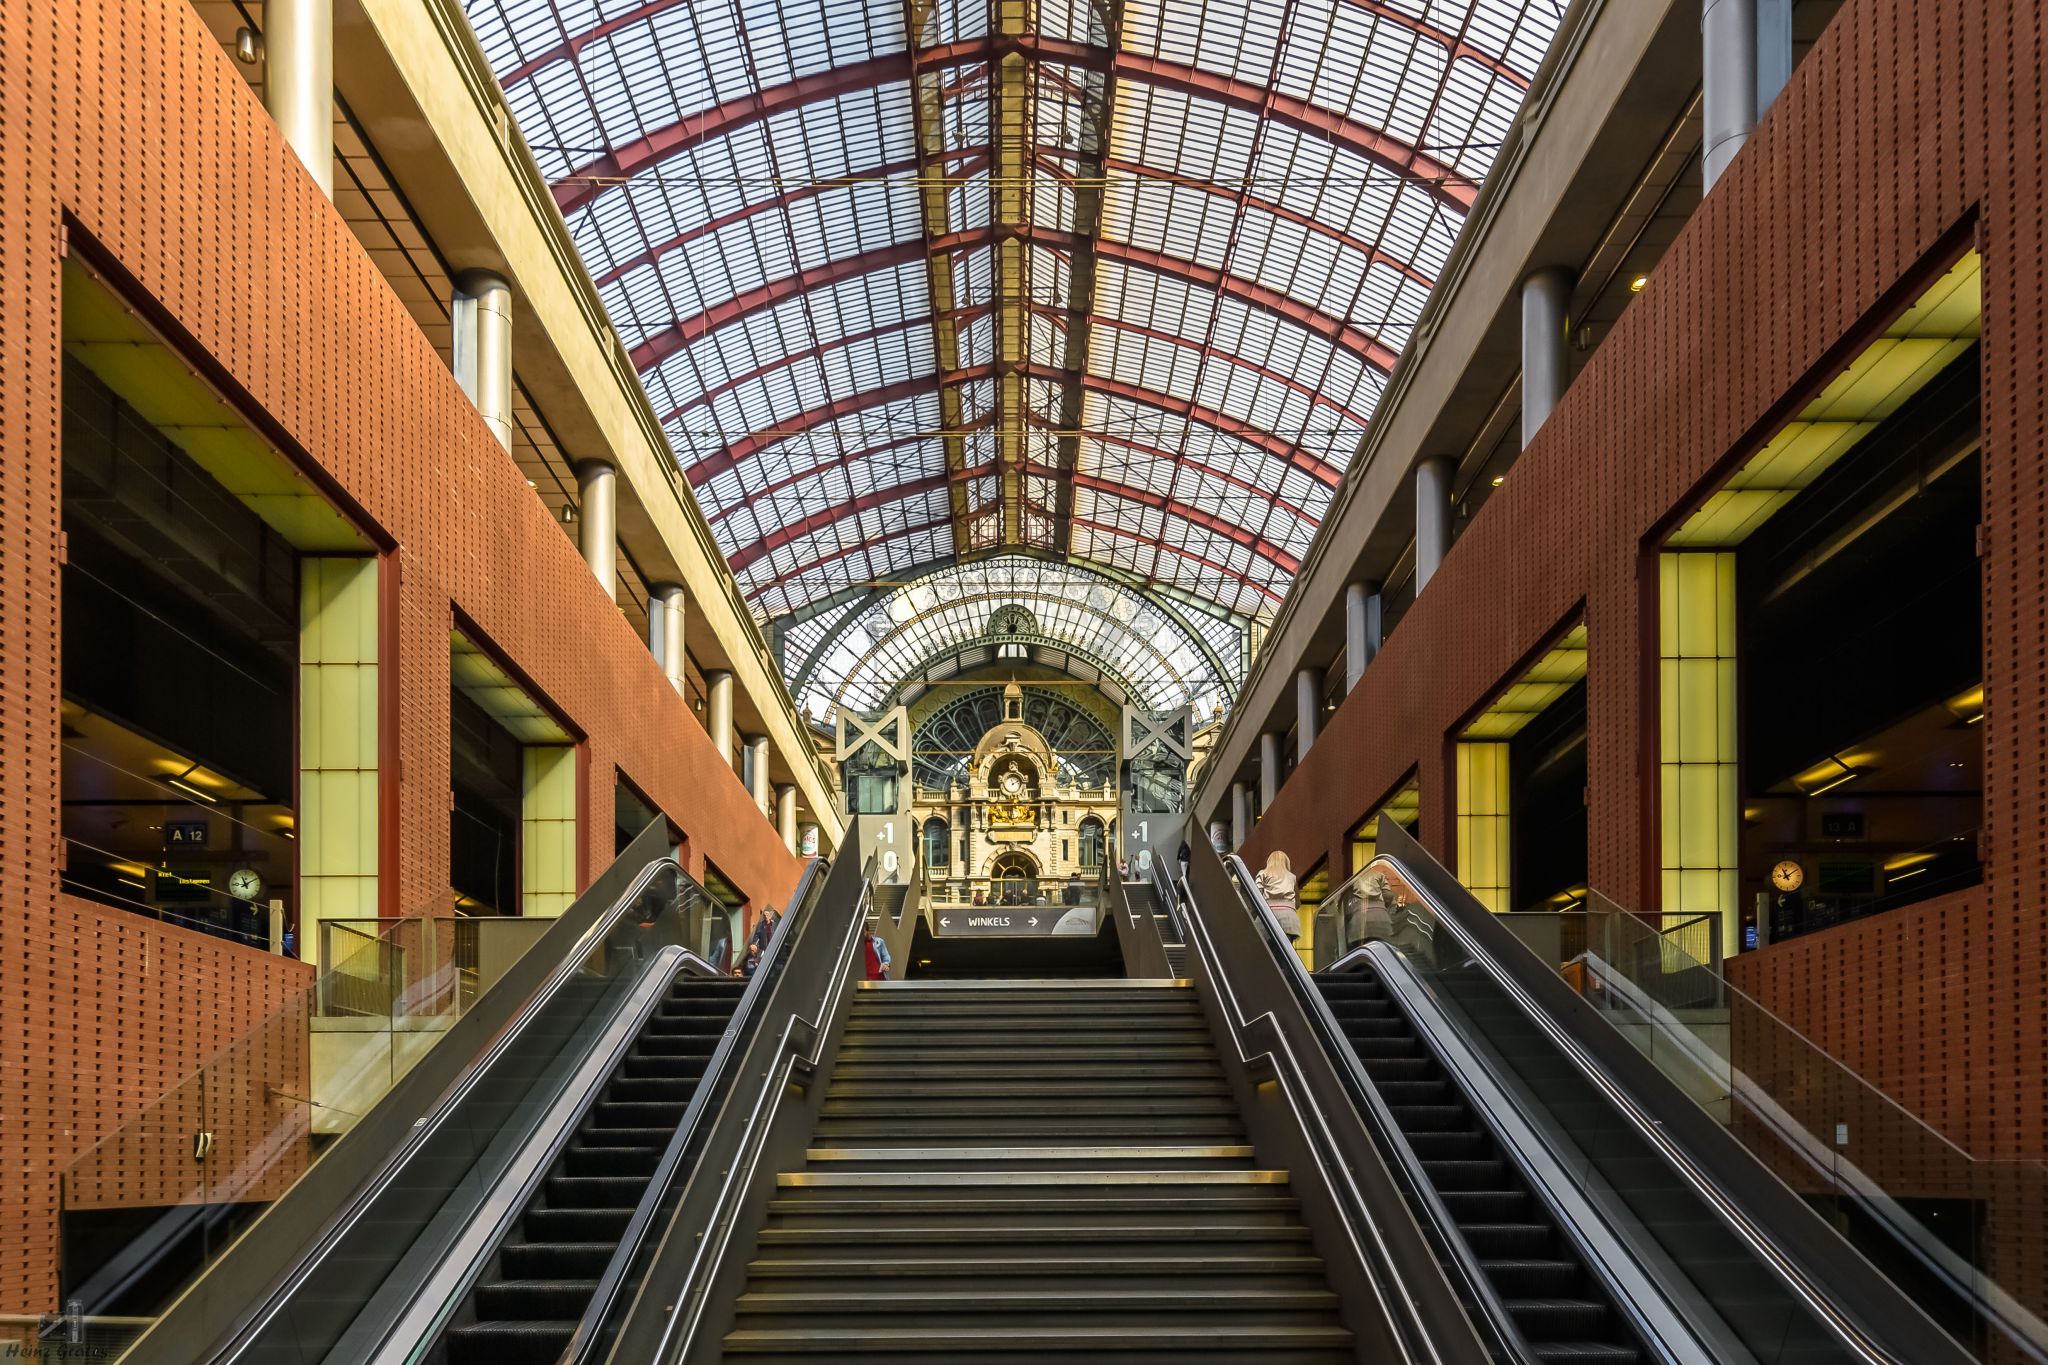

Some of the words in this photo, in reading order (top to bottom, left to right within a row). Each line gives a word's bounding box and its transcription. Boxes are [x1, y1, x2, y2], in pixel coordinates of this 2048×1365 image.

[172, 829, 183, 841] A
[190, 830, 203, 841] 12
[876, 822, 894, 844] +1
[1131, 820, 1148, 842] +1
[1828, 823, 1841, 832] 13
[1847, 822, 1857, 832] A
[883, 850, 897, 872] 0
[1138, 849, 1152, 870] 0
[968, 916, 1011, 927] WINKELS
